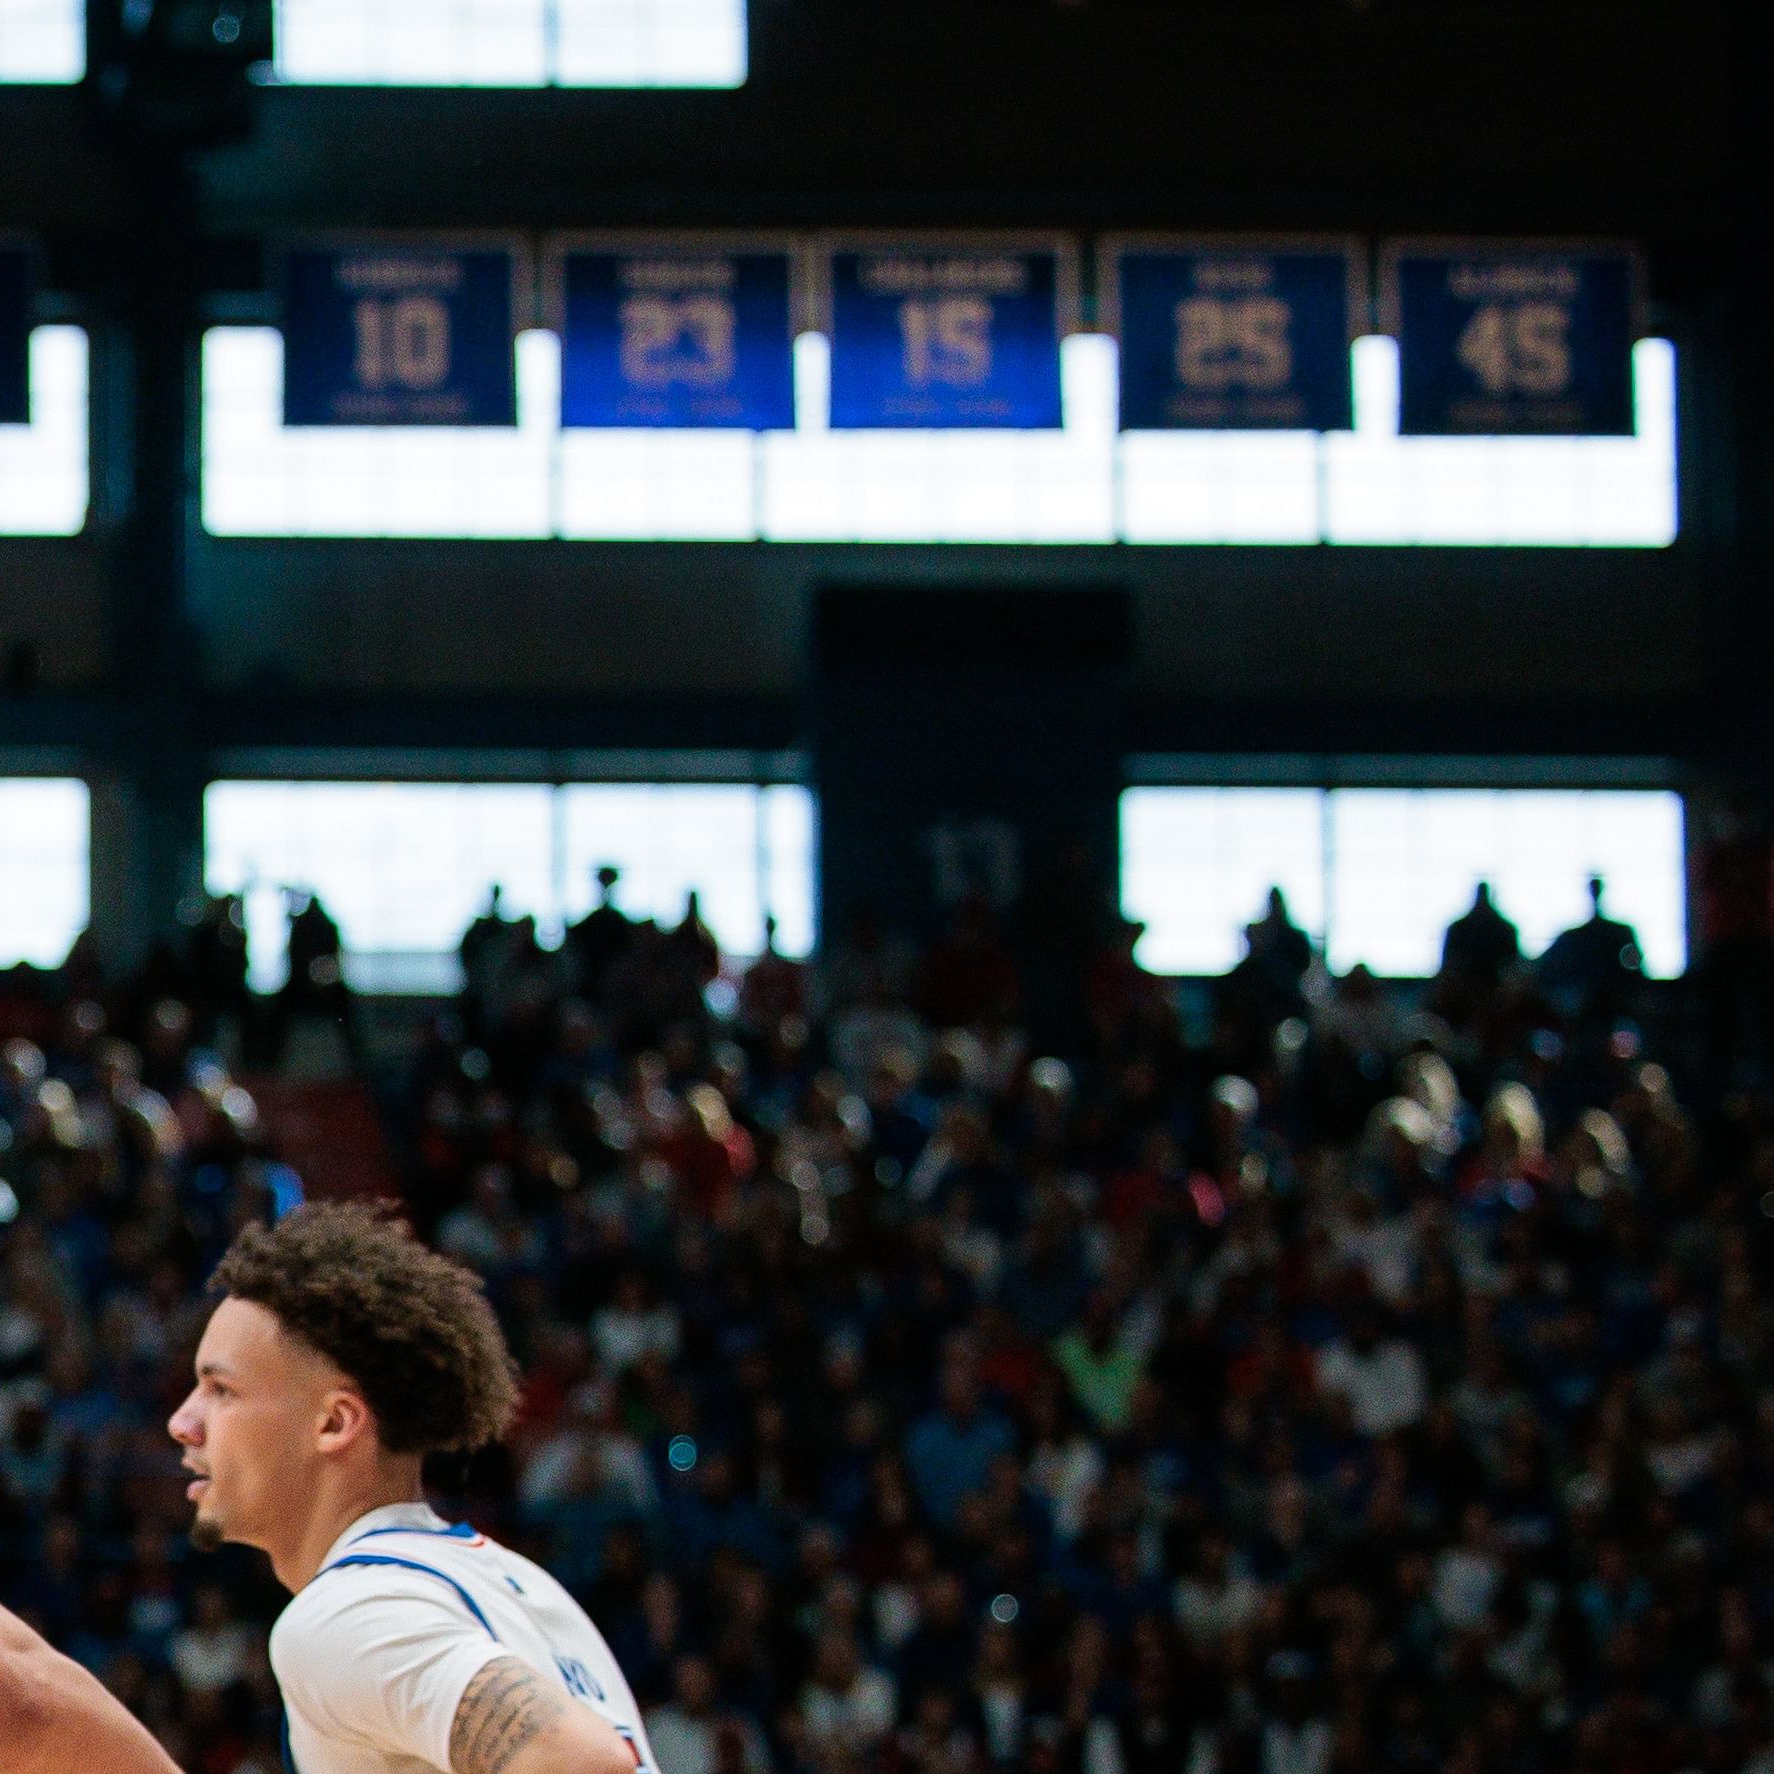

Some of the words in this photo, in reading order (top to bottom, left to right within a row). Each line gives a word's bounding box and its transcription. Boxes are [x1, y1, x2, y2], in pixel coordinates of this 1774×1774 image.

[355, 296, 450, 391] 10
[618, 296, 738, 387] 23
[898, 298, 996, 389] 15
[1173, 297, 1294, 392] 25
[1457, 301, 1573, 395] 45
